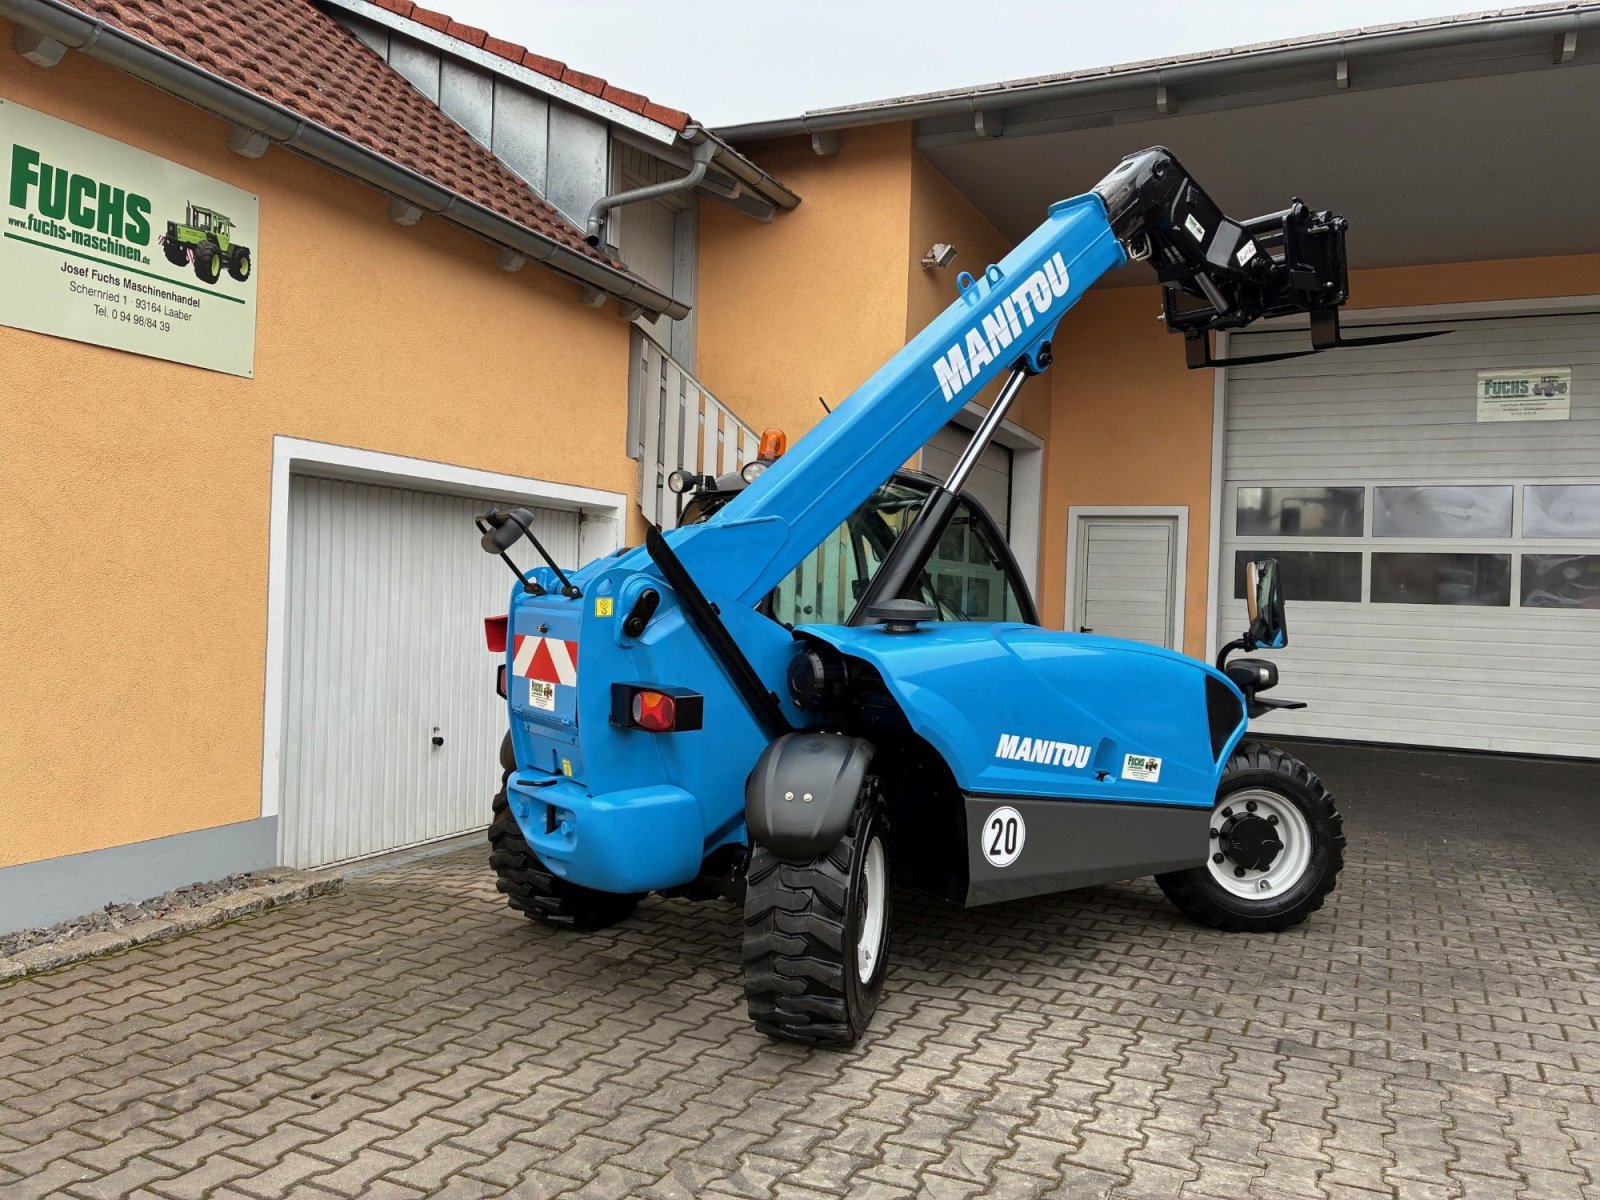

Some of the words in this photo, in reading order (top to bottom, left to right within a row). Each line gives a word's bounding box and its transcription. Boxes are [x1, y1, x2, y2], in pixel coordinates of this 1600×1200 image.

[9, 143, 151, 247] FUCHS
[8, 213, 151, 265] www.fuchs-maschinen.de
[61, 262, 89, 278] Josef
[91, 269, 120, 286] Fuchs
[123, 278, 200, 308] Maschinenhandel
[69, 280, 120, 303] Schernried
[135, 298, 162, 313] 93164
[164, 305, 192, 321] Laaber
[94, 304, 109, 318] Tel.
[112, 309, 118, 320] 0
[120, 311, 131, 323] 94
[133, 314, 157, 329] 98/84
[160, 321, 170, 332] 39
[932, 252, 1071, 402] MANITOU
[1484, 379, 1529, 396] FUCHS
[995, 733, 1092, 769] MANITOU
[1127, 755, 1145, 767] FUCHS
[989, 818, 1018, 856] 20
